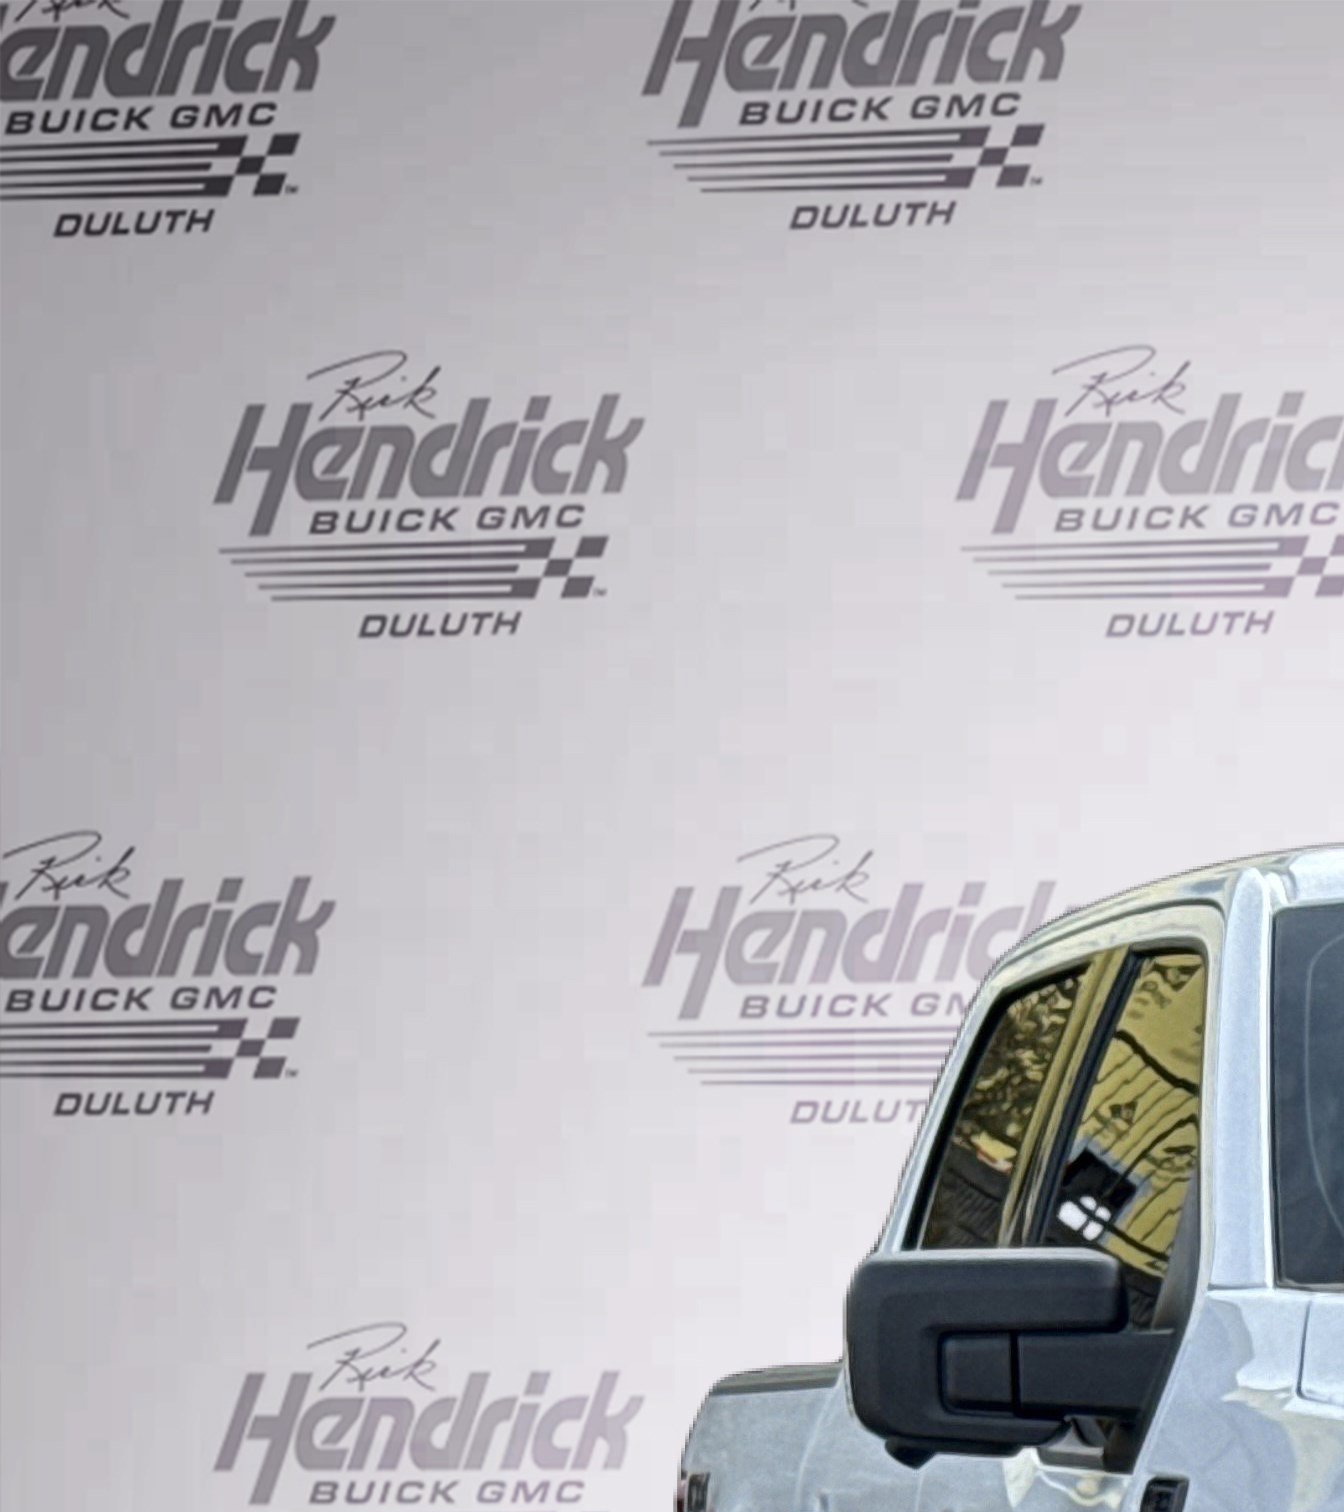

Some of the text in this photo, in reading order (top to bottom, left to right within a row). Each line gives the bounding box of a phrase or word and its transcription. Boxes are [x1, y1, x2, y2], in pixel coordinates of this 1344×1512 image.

[0, 0, 336, 102] endrick
[642, 0, 1082, 128] Hendrick
[5, 102, 277, 135] BUICK GMC
[739, 92, 1021, 125] BUICK GMC
[54, 209, 215, 237] DULUTH
[790, 201, 956, 230] DULUTH
[214, 394, 644, 537] Hendrick
[309, 504, 585, 534] BUICK GMC
[1055, 502, 1340, 532] BUICK GMC
[359, 612, 521, 638] DULUTH
[1106, 611, 1274, 637] DULUTH
[0, 876, 336, 980] endrick
[642, 880, 1057, 1020] Hendric
[5, 986, 276, 1012] BUICK GMC
[740, 992, 974, 1019] BUICK GM
[54, 1091, 214, 1116] DULUTH
[790, 1100, 926, 1124] DULUT
[214, 1371, 643, 1505] Hendrick
[309, 1481, 584, 1504] BUICK GMC
